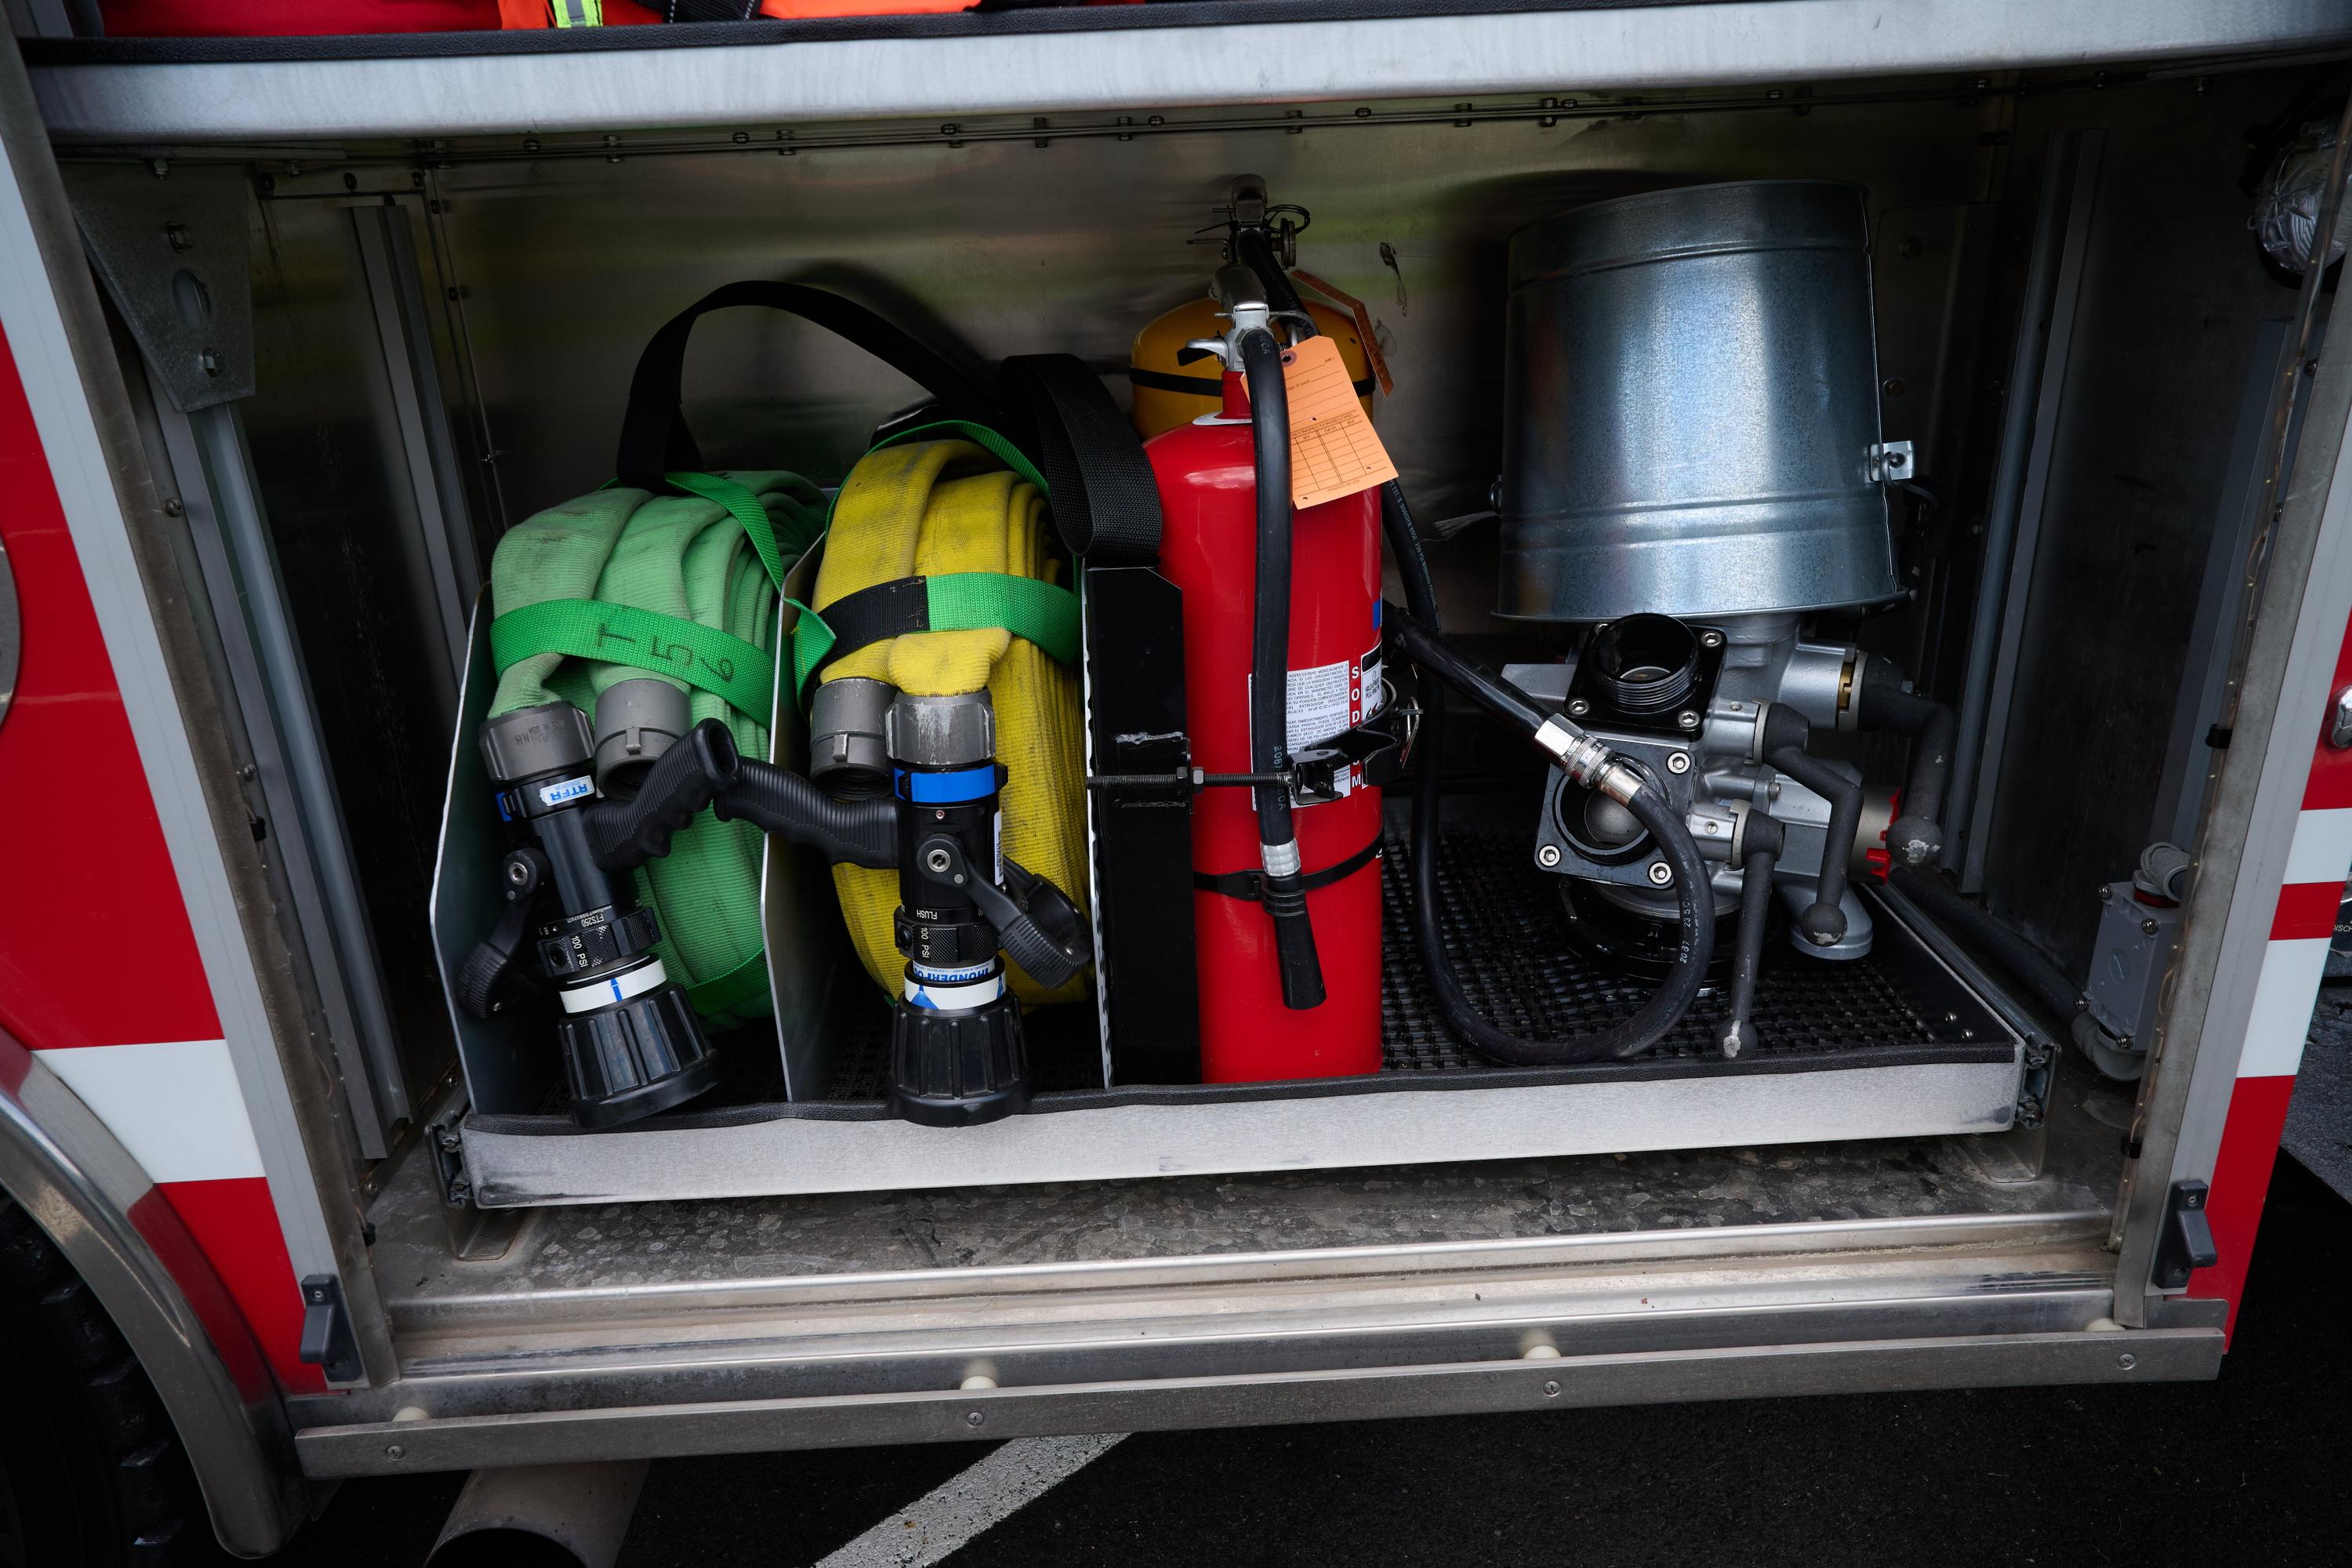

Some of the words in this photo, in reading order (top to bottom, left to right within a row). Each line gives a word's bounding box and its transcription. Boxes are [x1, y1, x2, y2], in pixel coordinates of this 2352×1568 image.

[550, 783, 588, 801] RTFR
[581, 913, 604, 927] FTS250
[916, 909, 938, 920] FLUSH
[920, 927, 929, 938] 100
[571, 935, 583, 949] 100
[577, 953, 588, 967] PSI
[921, 944, 930, 958] PSI
